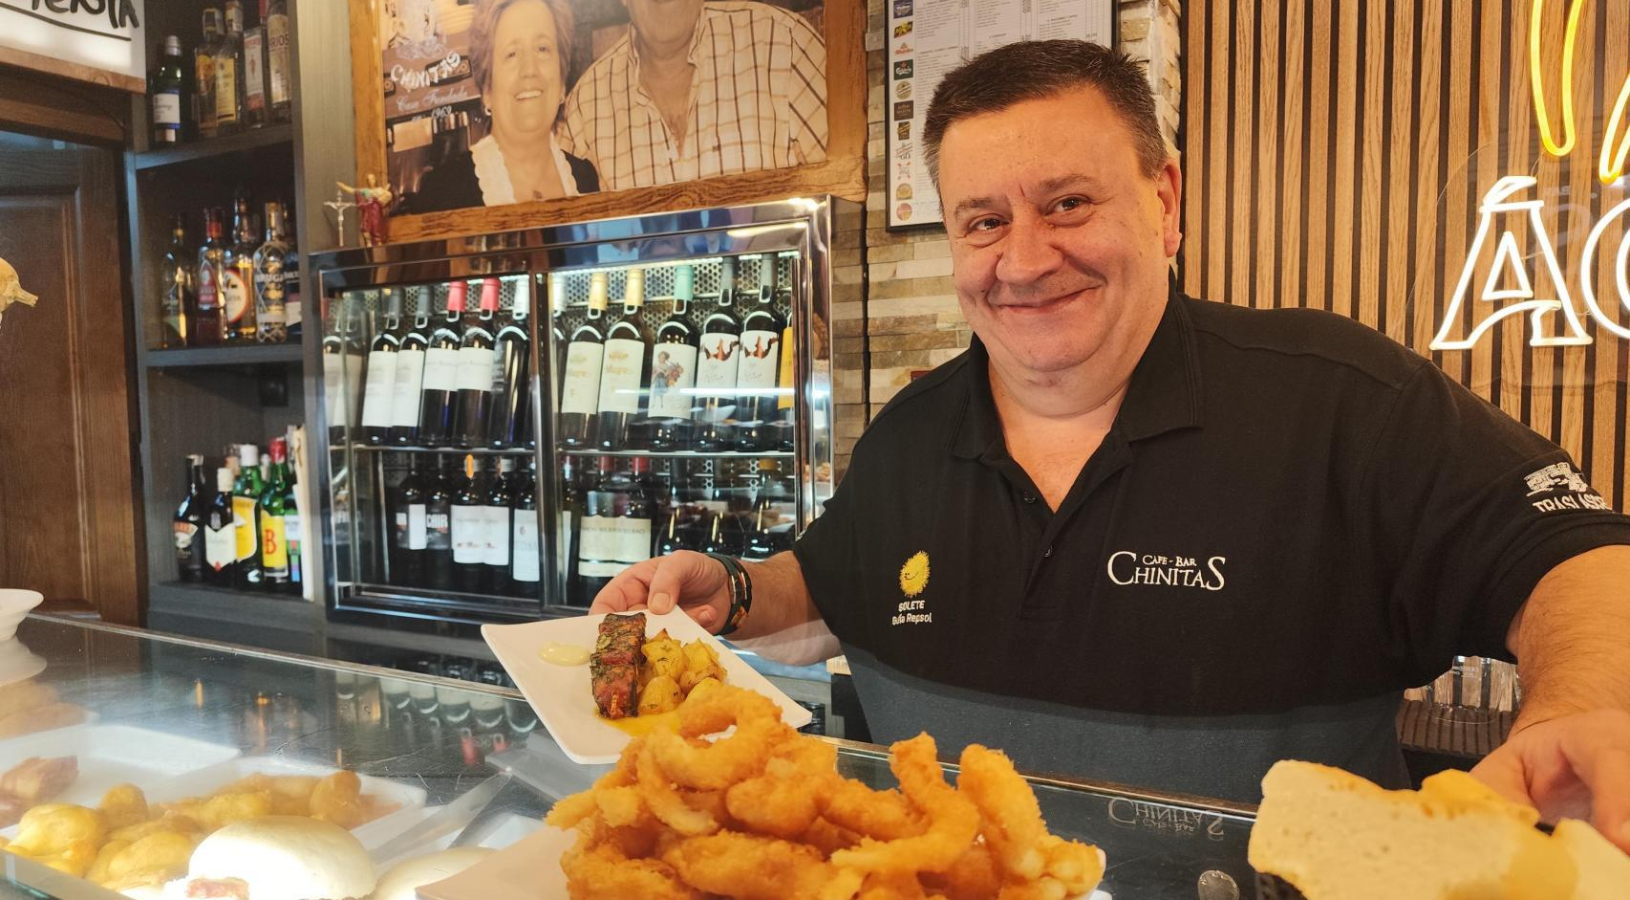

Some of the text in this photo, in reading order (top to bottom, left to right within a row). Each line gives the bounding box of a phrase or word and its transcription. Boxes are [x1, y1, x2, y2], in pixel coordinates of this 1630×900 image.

[1175, 556, 1197, 567] BAR
[1107, 551, 1226, 591] CHINITAS
[898, 600, 925, 612] SOLETE
